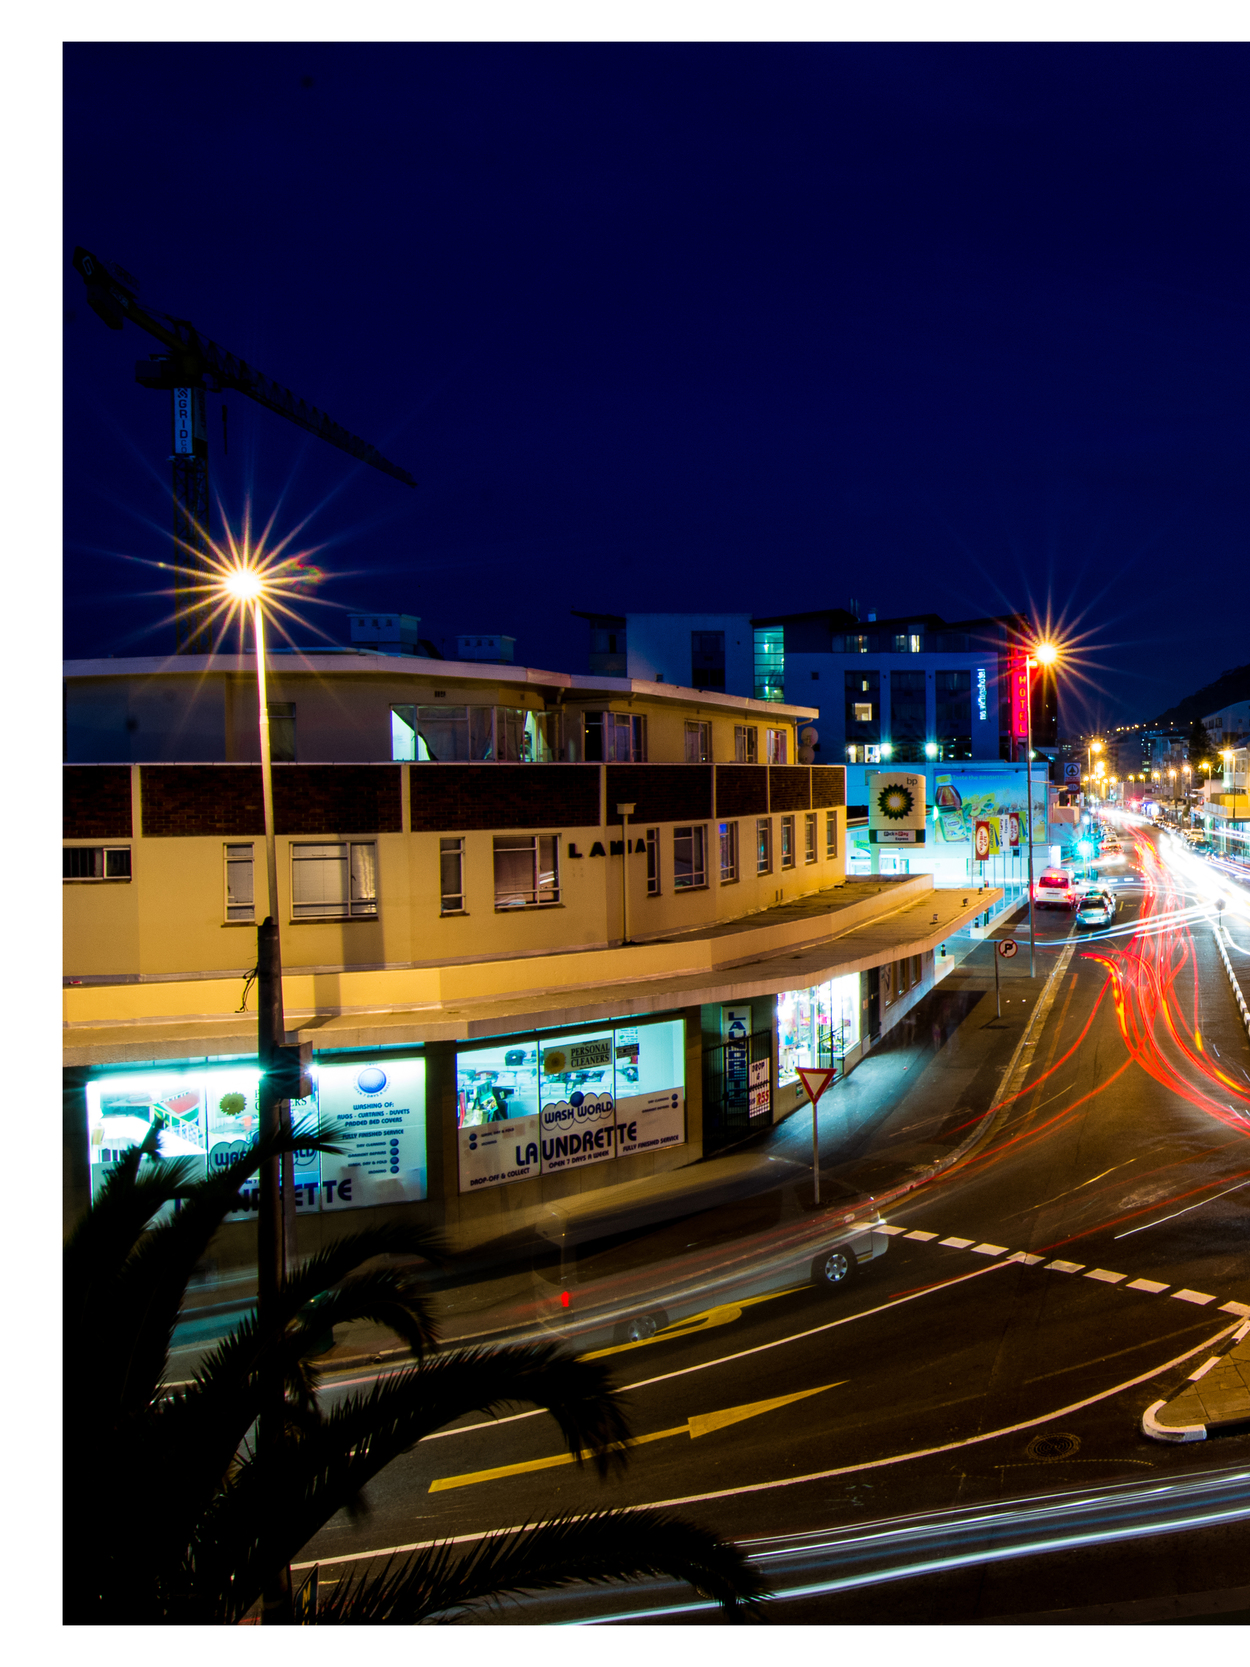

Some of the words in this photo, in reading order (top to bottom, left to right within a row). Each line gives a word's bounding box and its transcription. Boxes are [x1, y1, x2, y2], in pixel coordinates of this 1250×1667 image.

[1019, 676, 1027, 733] HOTEL
[906, 777, 918, 786] bp
[570, 1043, 611, 1057] PERSONAL
[570, 1053, 610, 1068] CLEANERS
[358, 1111, 385, 1119] CURTAINS
[544, 1107, 574, 1124] WASH
[577, 1101, 613, 1117] WORLD
[623, 1144, 637, 1152] FULLY
[638, 1139, 660, 1149] FINISHED
[660, 1135, 679, 1144] SERVICE
[549, 1160, 565, 1169] OPEN
[572, 1155, 586, 1163] DAYS
[593, 1150, 609, 1158] WEEK
[470, 1174, 500, 1186] DROP-OFF
[507, 1167, 530, 1178] COLLECT
